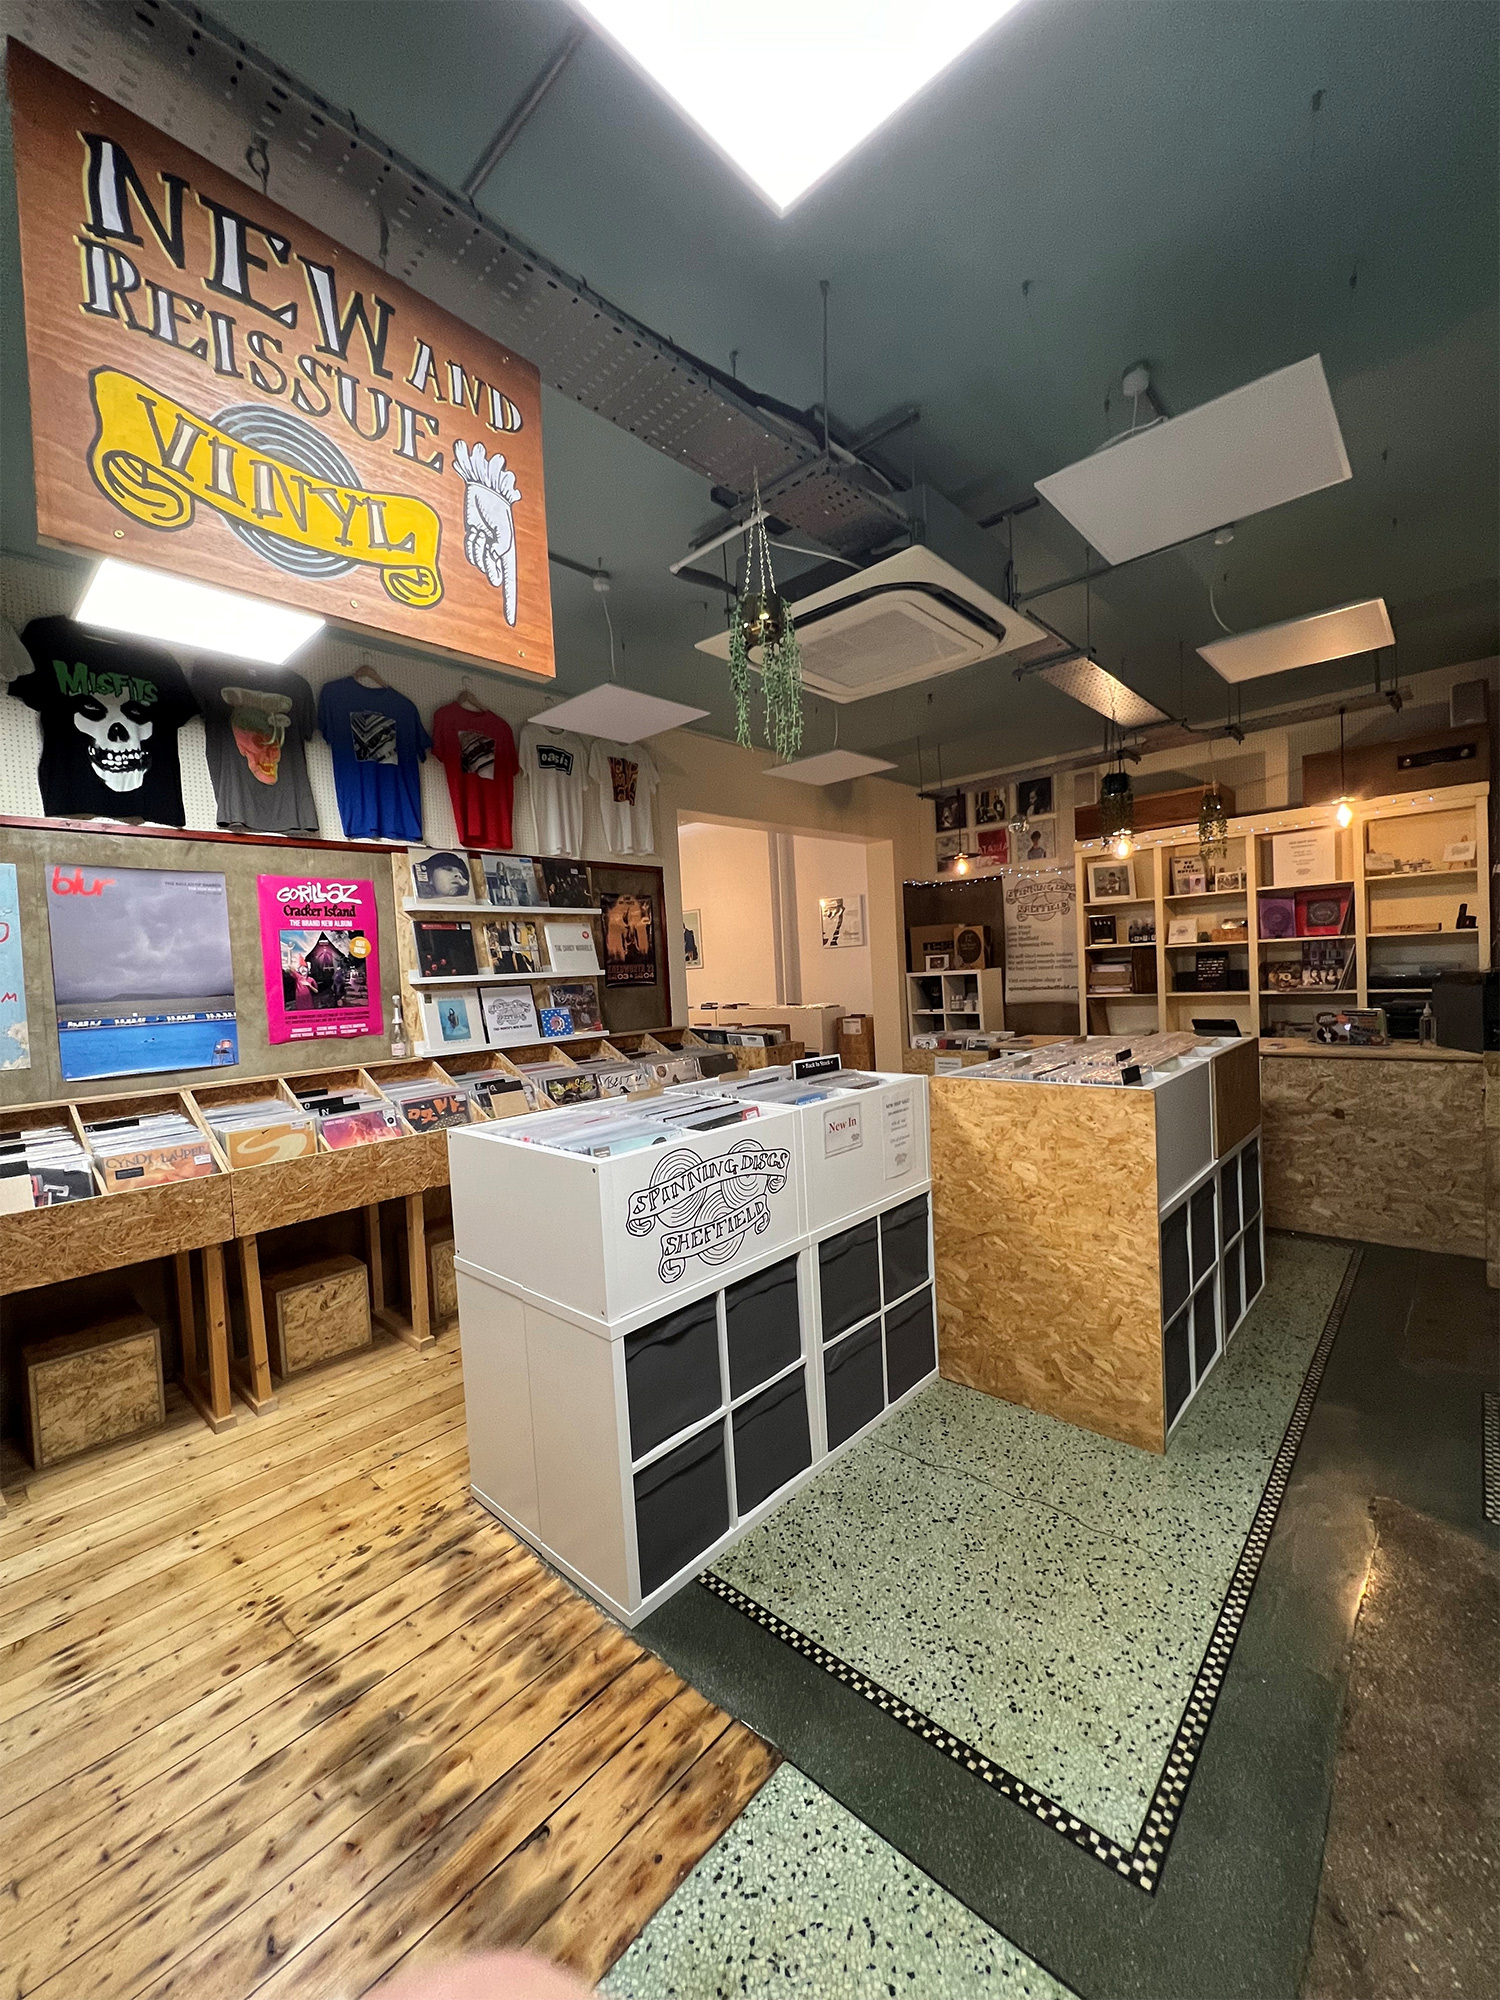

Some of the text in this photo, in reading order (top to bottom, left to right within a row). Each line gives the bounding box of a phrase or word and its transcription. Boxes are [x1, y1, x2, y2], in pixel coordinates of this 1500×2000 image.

[76, 130, 524, 434] NEW AND
[76, 234, 445, 474] REISSUE
[137, 394, 418, 554] VINYL
[541, 752, 569, 767] oasis
[51, 866, 117, 896] blur
[283, 904, 356, 918] Cracker Island
[289, 919, 353, 927] THE BRAND NEW ALBUM
[605, 1074, 633, 1089] BEST
[321, 1108, 330, 1116] N
[829, 1117, 857, 1133] New In
[105, 1145, 205, 1170] CYNDI LAUPER
[633, 1152, 789, 1215] SPINNING DISCS
[664, 1201, 765, 1257] SHEFFIELD
